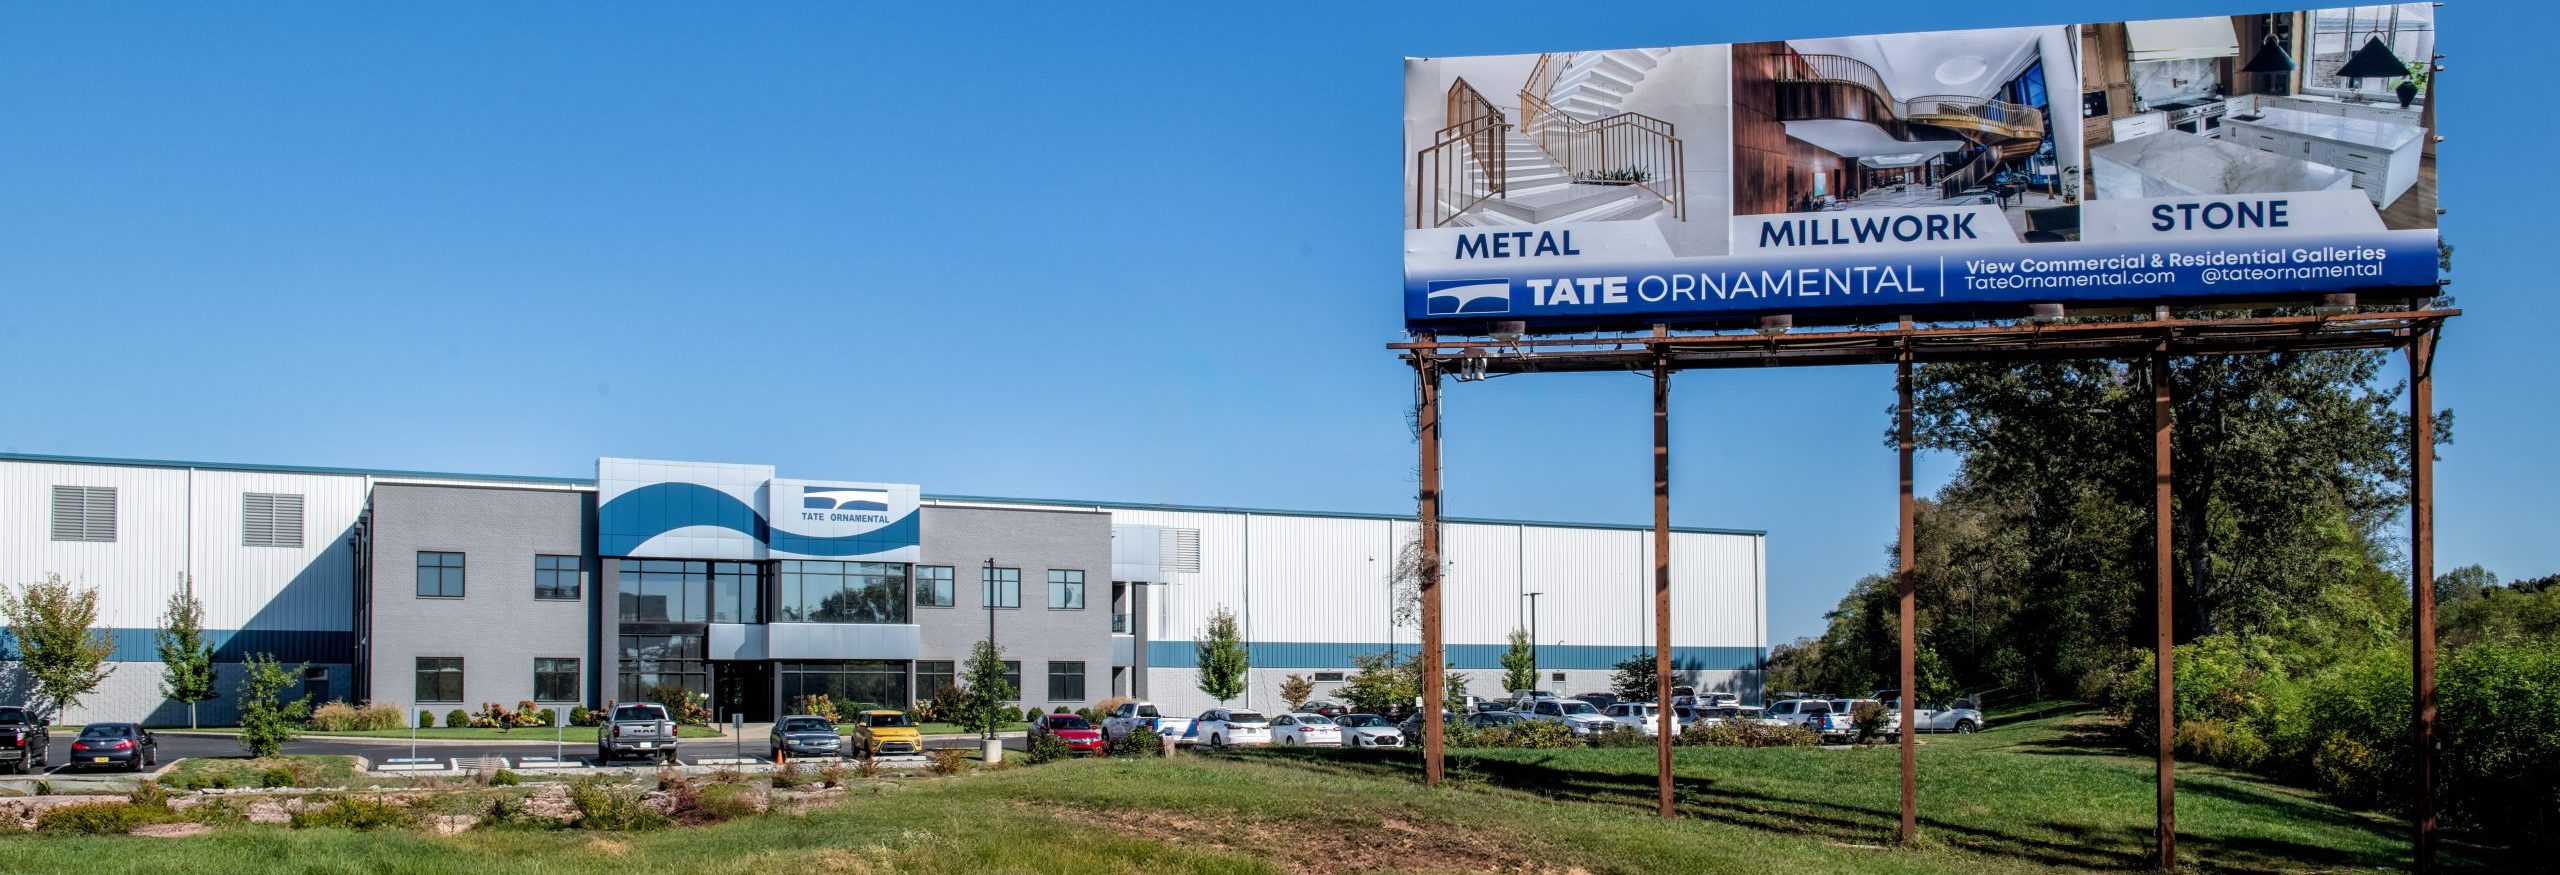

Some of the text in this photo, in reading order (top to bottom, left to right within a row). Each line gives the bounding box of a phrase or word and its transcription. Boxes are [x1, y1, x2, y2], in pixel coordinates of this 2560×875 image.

[1759, 213, 1978, 248] MILLWORK
[2151, 200, 2289, 232] STONE
[1455, 230, 1580, 260] METAL
[1966, 245, 2387, 275] View Commercial & Residential Galleries
[1526, 264, 1925, 306] TATE ORNAMENTAL
[1965, 261, 2383, 290] TateOrnamental.com @tateornamental
[802, 512, 890, 524] TATE ORNAMENTAL
